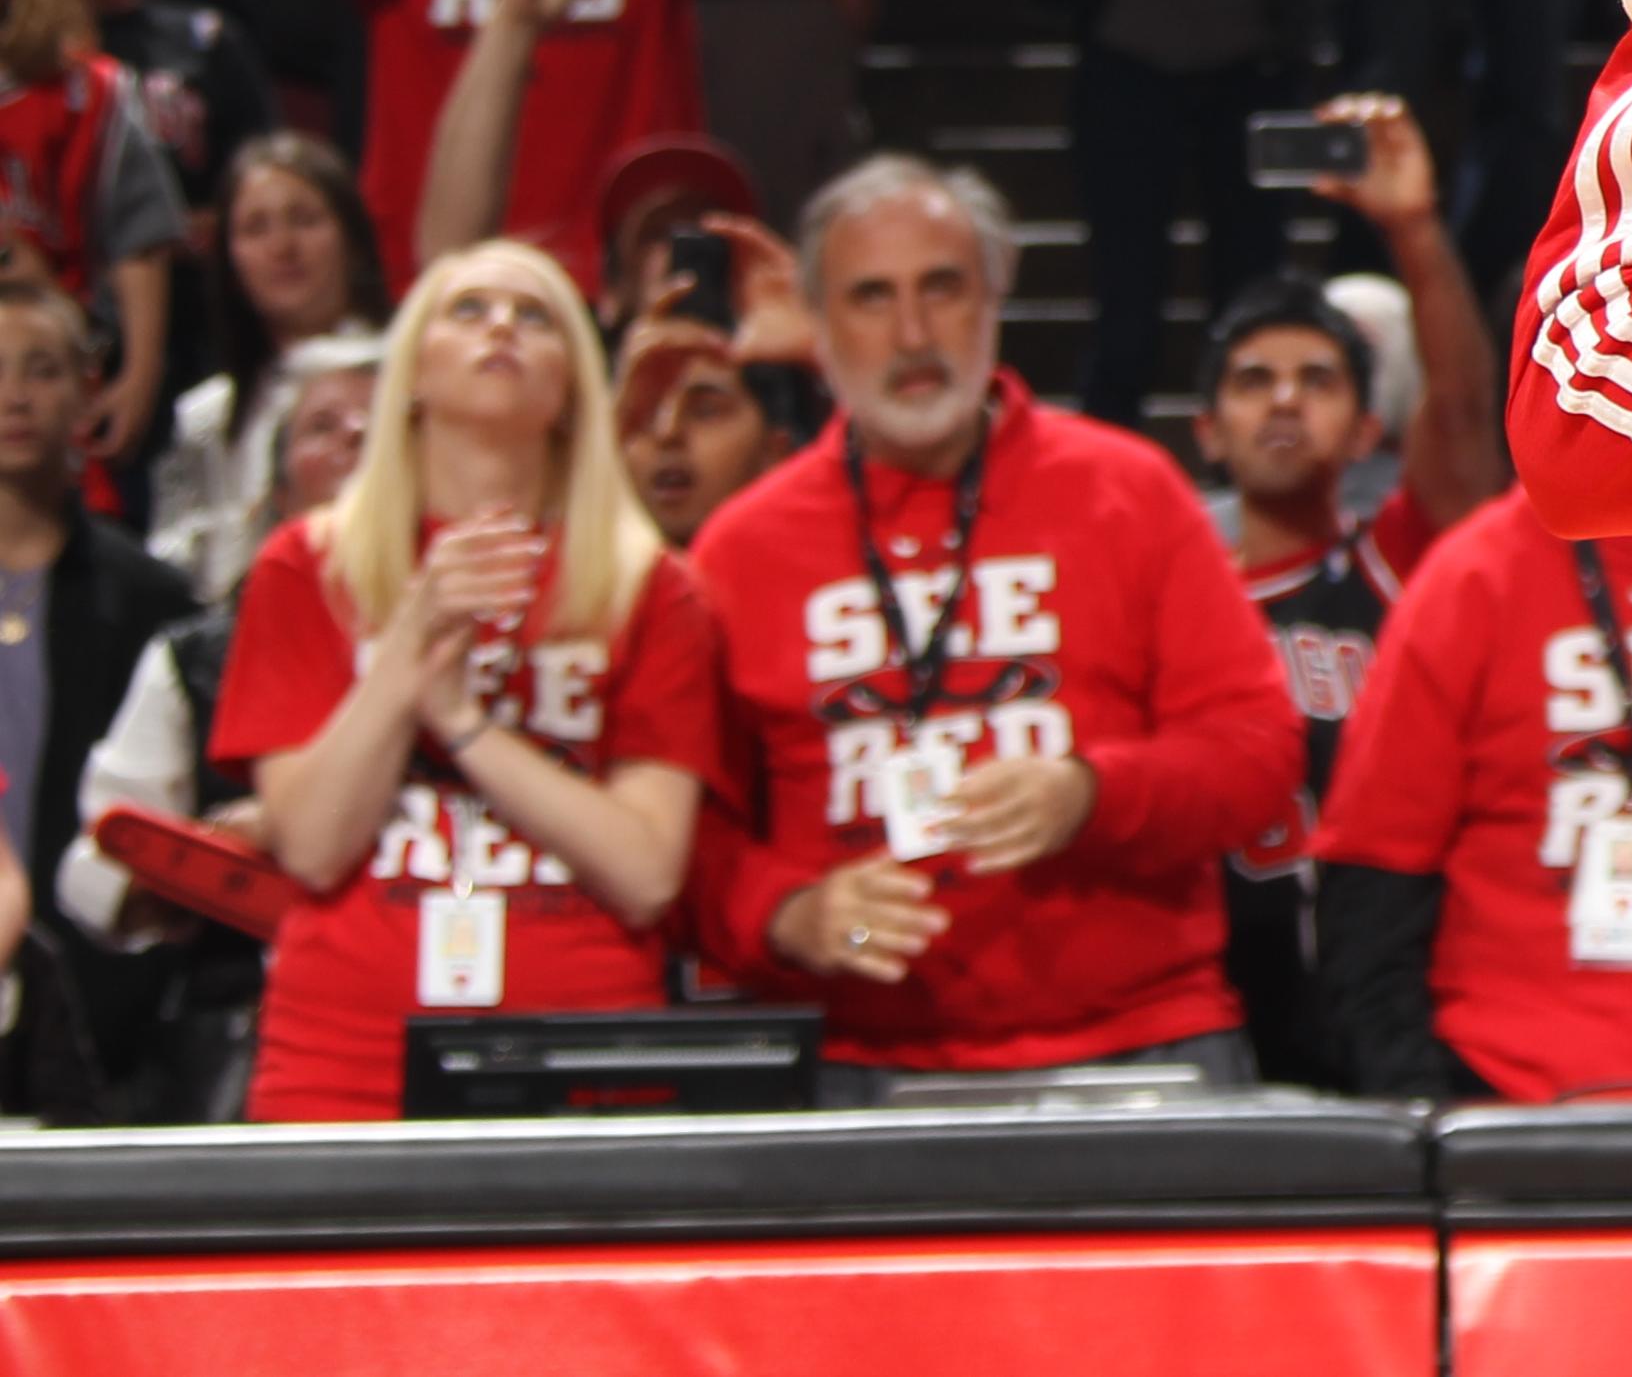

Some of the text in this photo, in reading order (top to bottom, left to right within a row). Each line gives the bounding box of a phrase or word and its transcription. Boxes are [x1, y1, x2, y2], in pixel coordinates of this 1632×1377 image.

[805, 555, 1061, 682] SEE
[356, 636, 608, 741] EE
[370, 784, 574, 886] RE
